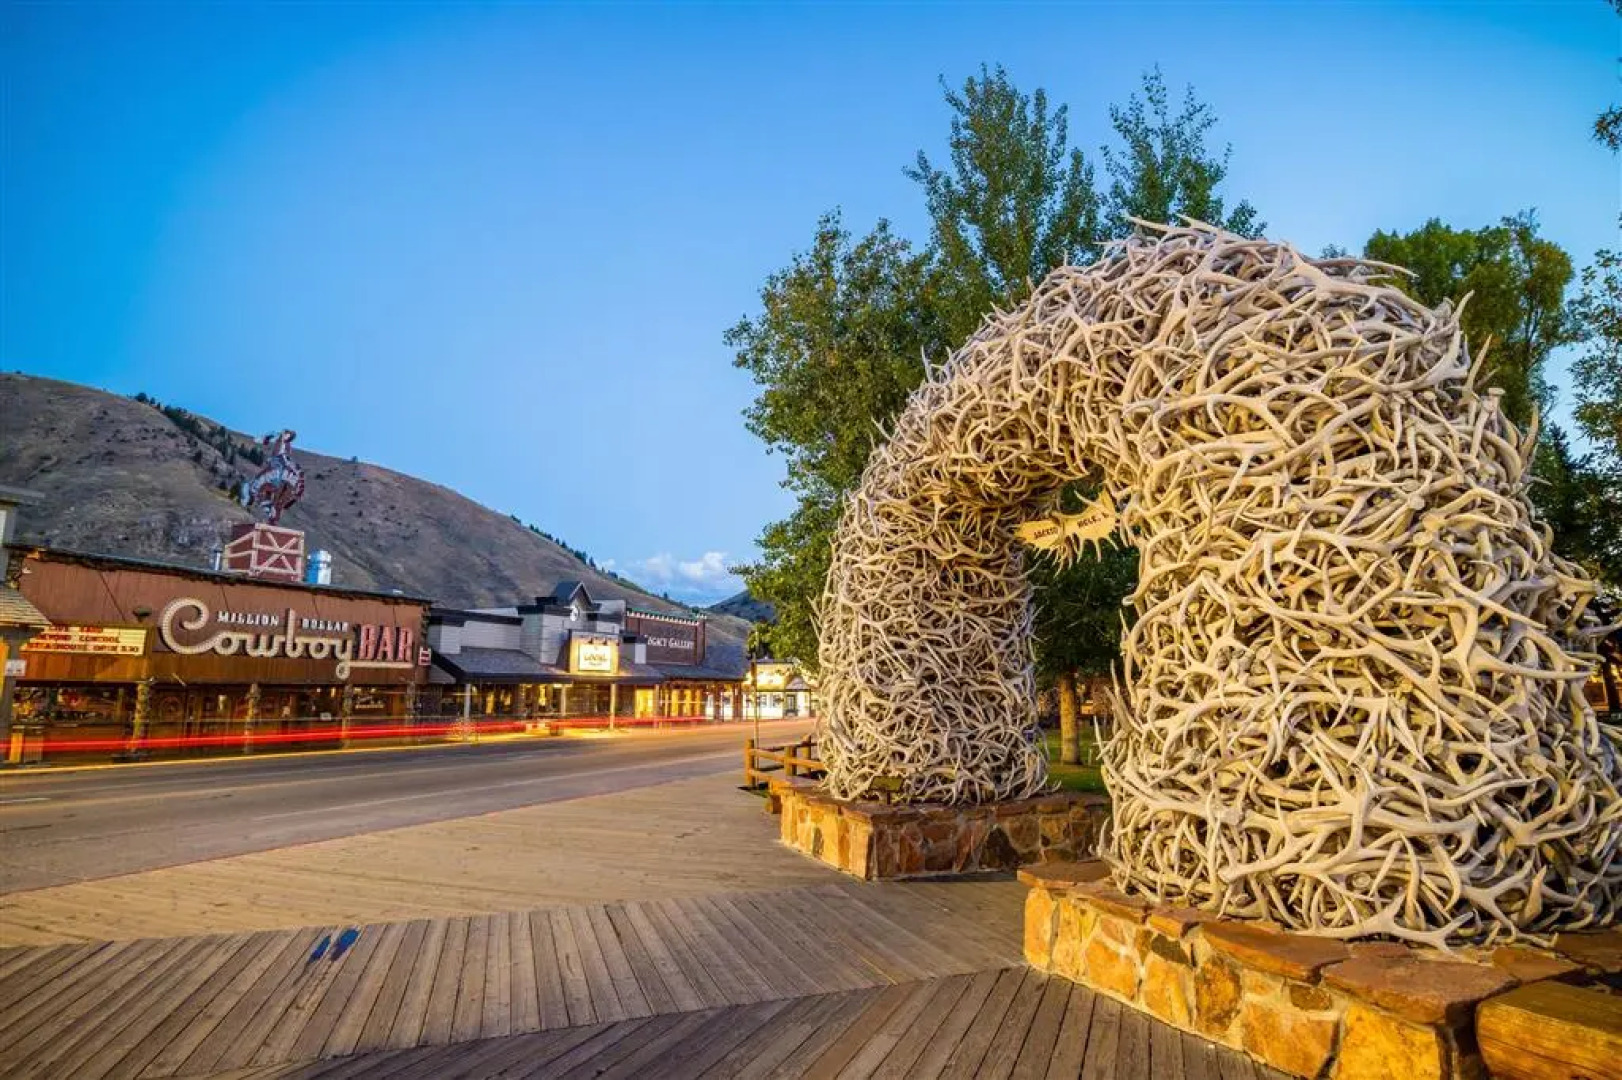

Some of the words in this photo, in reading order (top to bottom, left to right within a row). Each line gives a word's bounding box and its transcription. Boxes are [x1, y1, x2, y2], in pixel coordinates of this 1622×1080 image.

[217, 611, 279, 626] MILLION
[303, 618, 349, 632] DOLLAR
[161, 598, 352, 679] Cowboy
[359, 623, 413, 662] BAR
[669, 638, 695, 649] GALLERY
